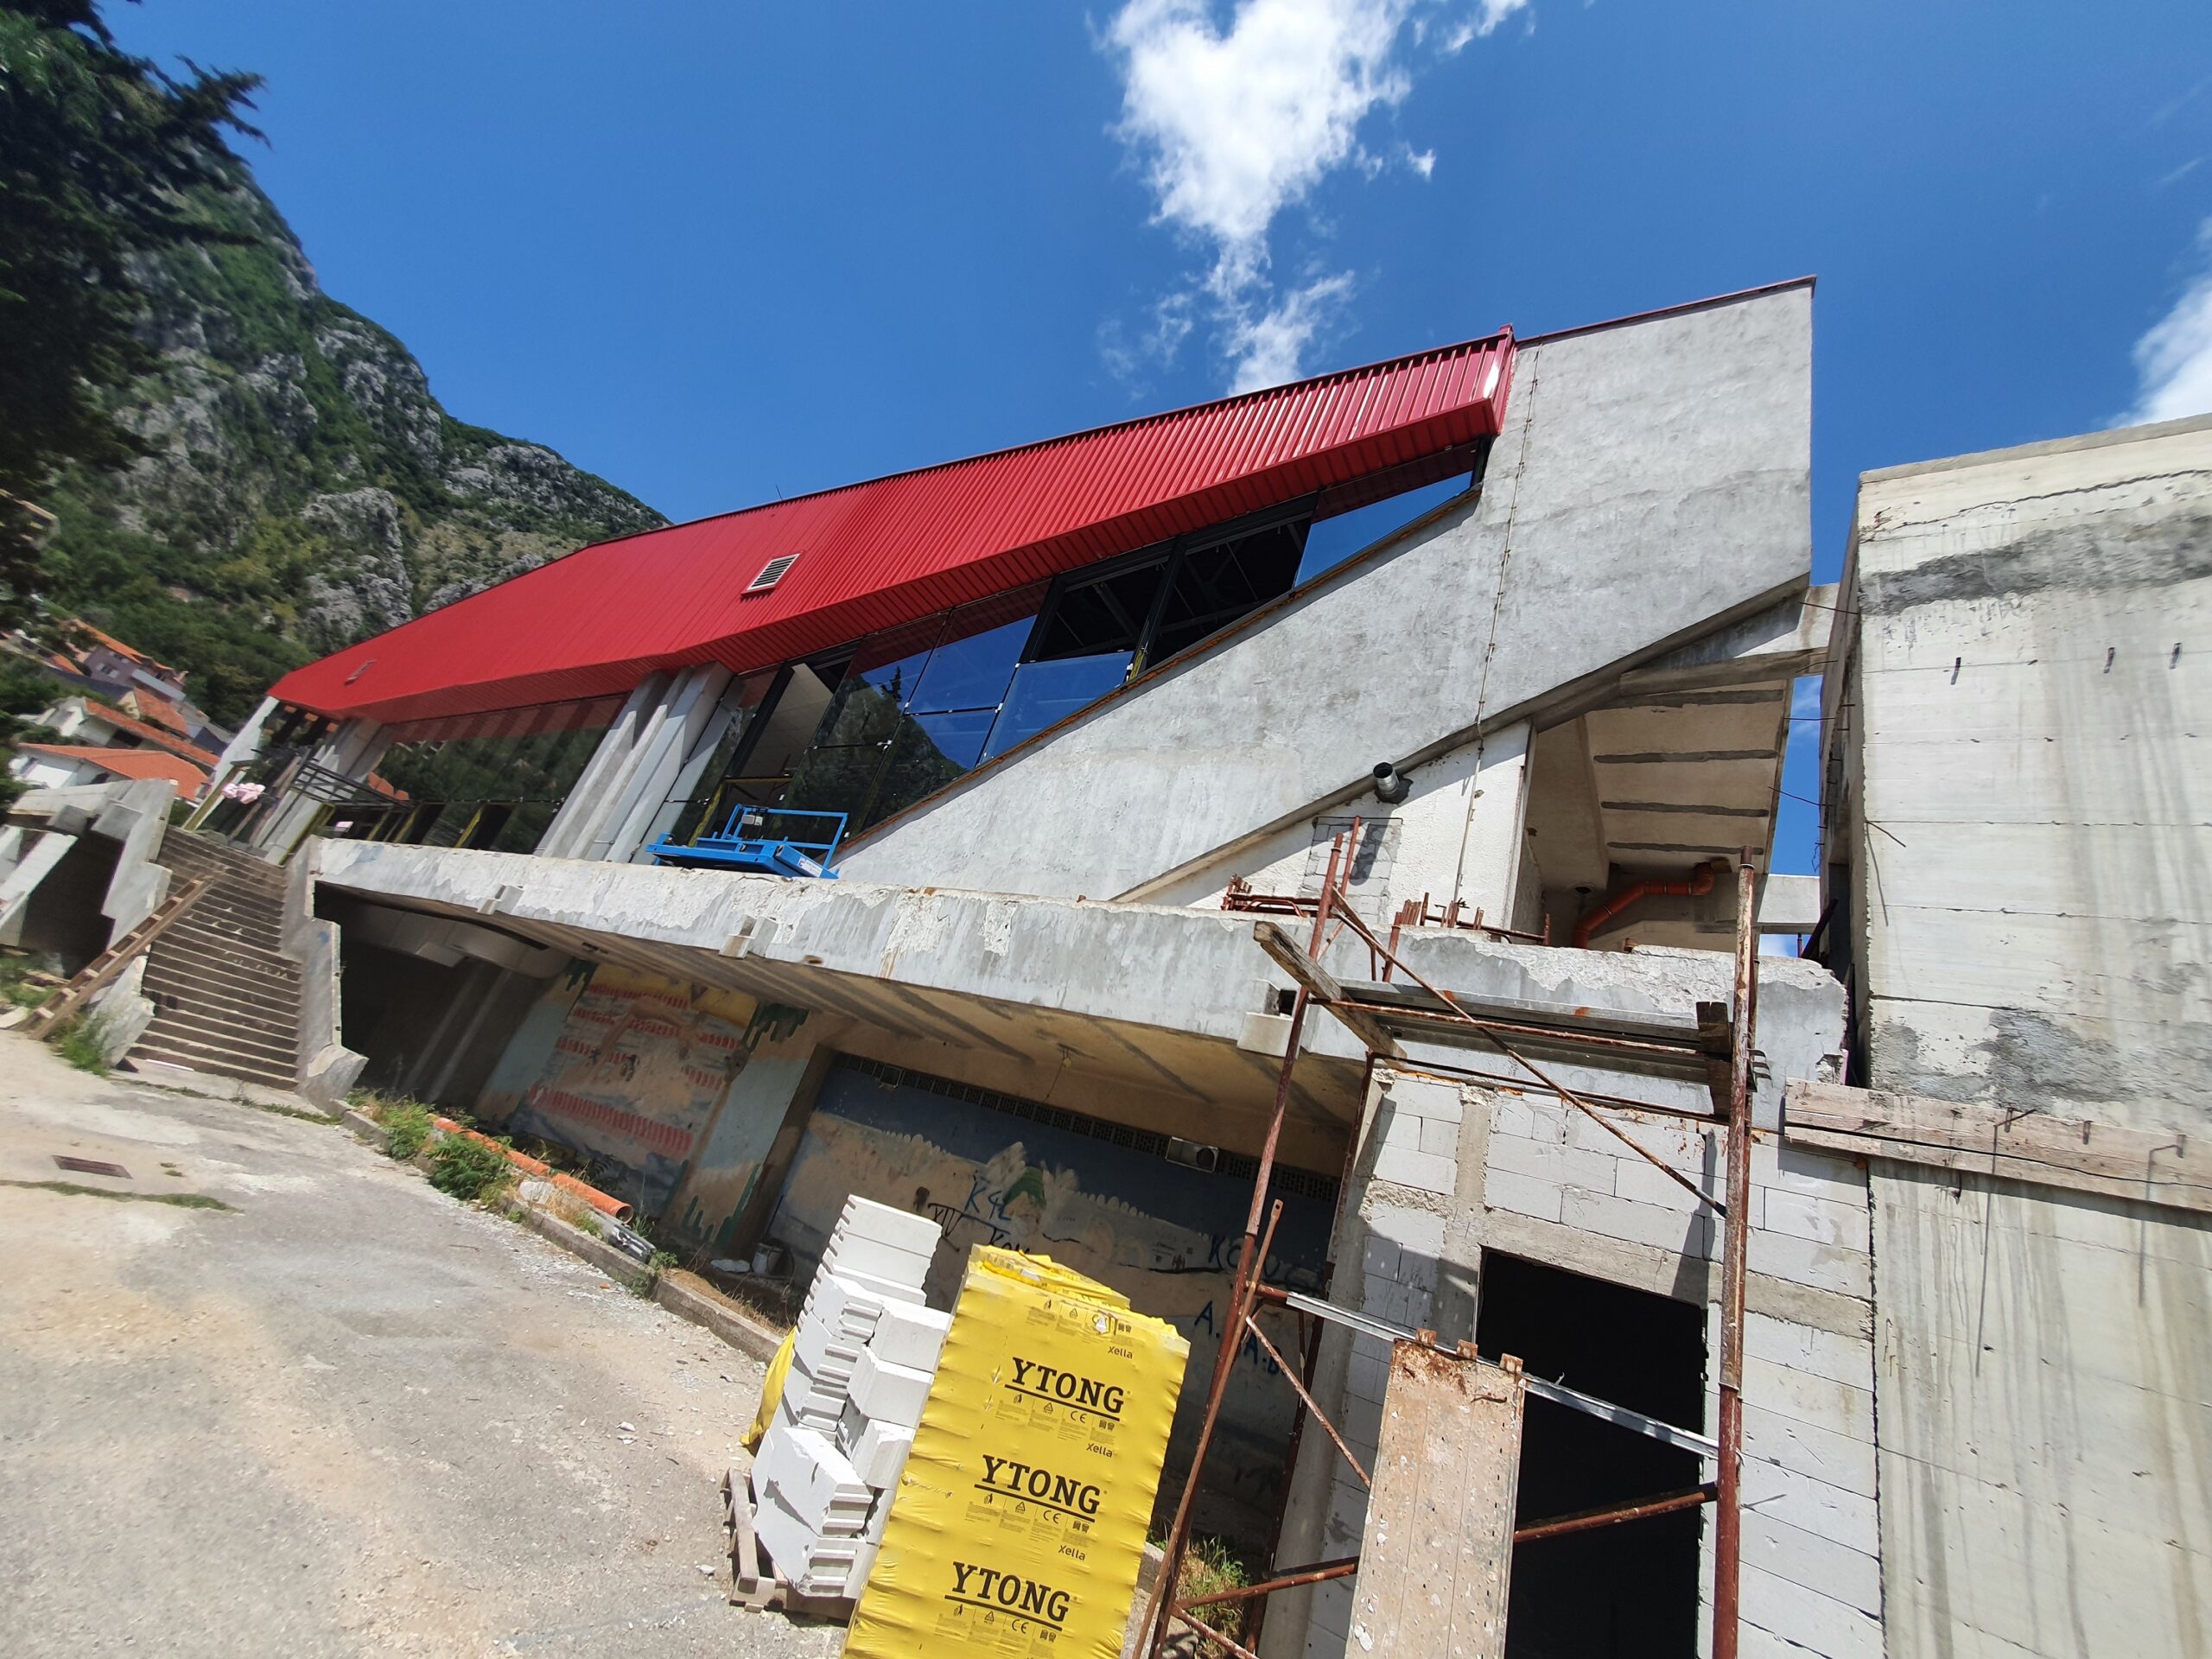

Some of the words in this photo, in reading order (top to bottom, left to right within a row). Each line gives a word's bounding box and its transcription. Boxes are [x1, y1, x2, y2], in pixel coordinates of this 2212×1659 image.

[1011, 1357, 1124, 1414] YTONG
[982, 1454, 1101, 1515] YTONG
[951, 1560, 1071, 1623] YTONG
